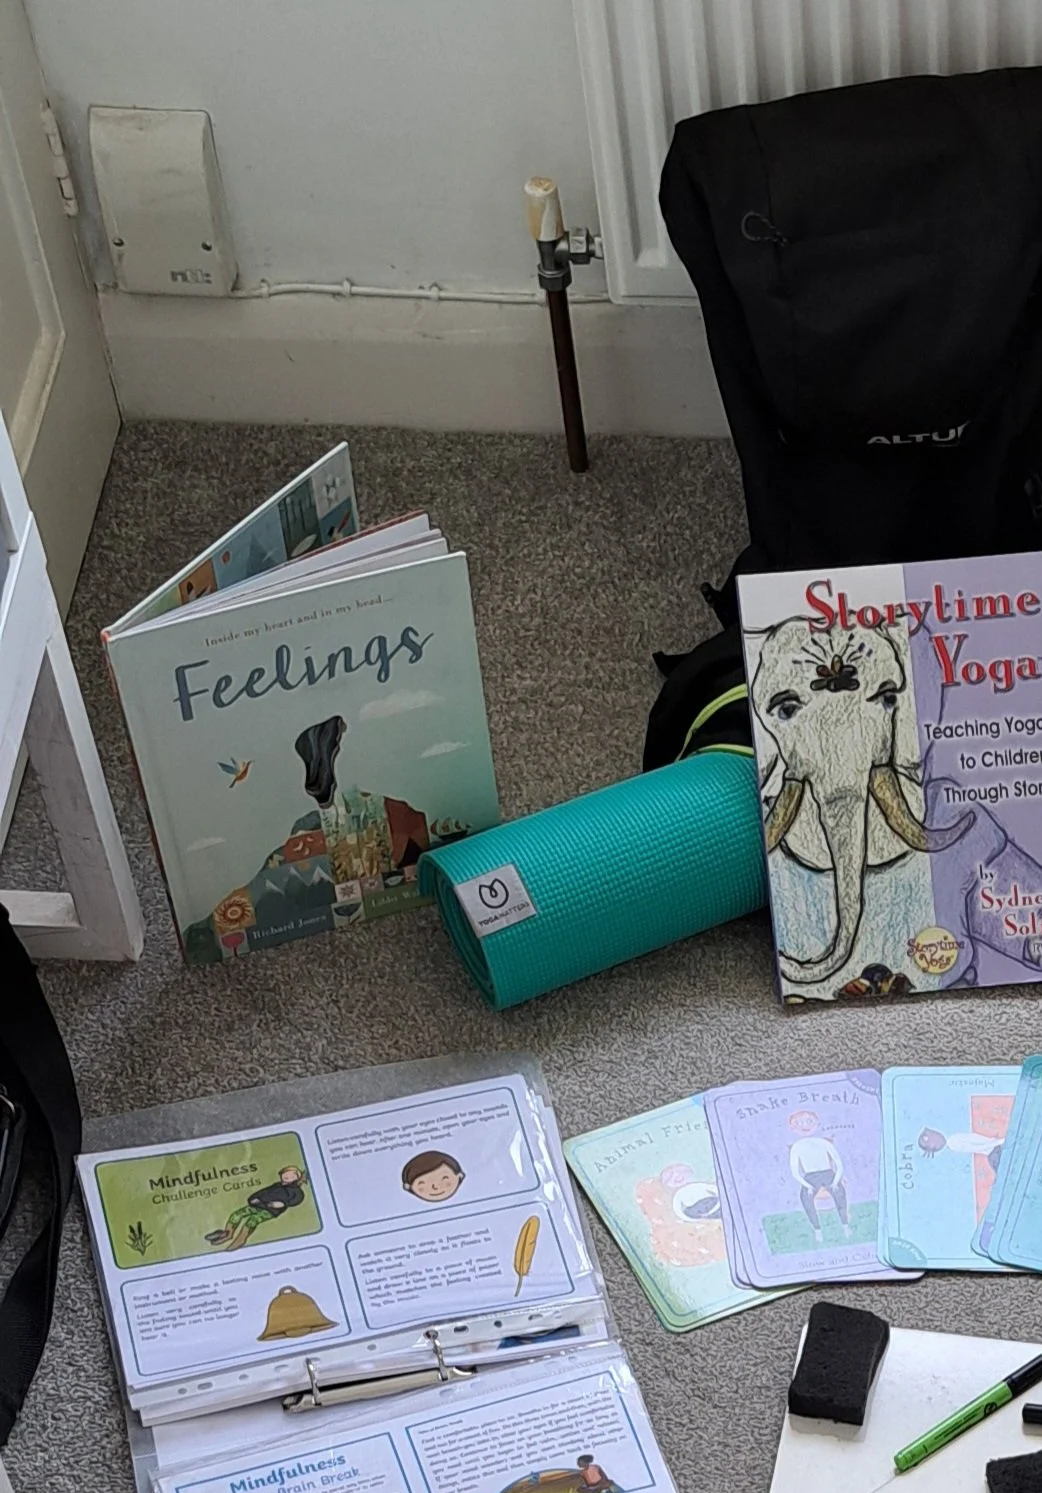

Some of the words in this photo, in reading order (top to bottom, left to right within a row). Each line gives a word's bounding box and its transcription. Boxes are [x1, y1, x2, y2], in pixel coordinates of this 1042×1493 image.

[804, 579, 1042, 636] Storytime
[172, 626, 434, 722] Feelings
[924, 720, 1000, 741] Teaching
[960, 753, 977, 770] to
[943, 783, 1009, 804] Through
[978, 863, 995, 882] by
[252, 922, 294, 941] Richard
[736, 1095, 789, 1121] Snake
[798, 1090, 860, 1107] Breath
[593, 1132, 655, 1174] Animal
[897, 1142, 915, 1191] Cobra
[149, 1162, 258, 1191] Mindfulness
[152, 1186, 218, 1205] Challenge
[222, 1177, 262, 1193] Cards
[321, 1467, 361, 1484] Break
